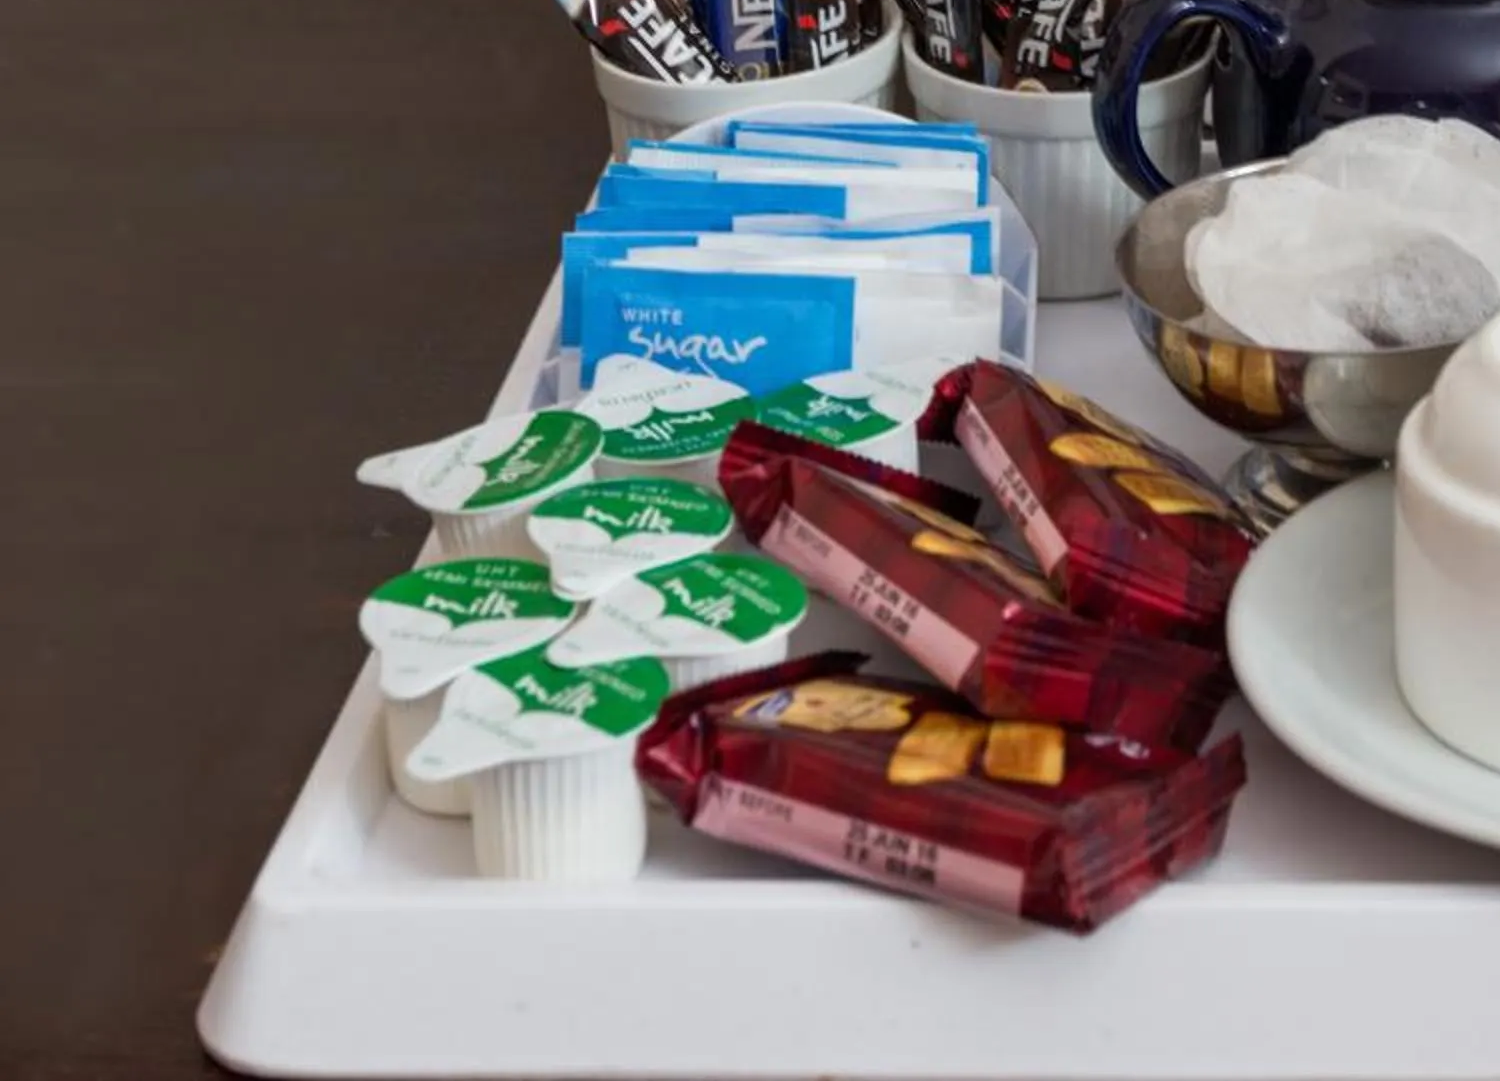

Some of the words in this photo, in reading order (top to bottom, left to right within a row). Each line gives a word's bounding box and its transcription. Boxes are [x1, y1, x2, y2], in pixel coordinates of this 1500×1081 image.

[621, 307, 683, 327] WHITE
[584, 505, 674, 533] milk
[475, 563, 520, 577] UHT
[423, 592, 520, 620] milk
[662, 577, 735, 629] milk
[513, 674, 598, 717] milk
